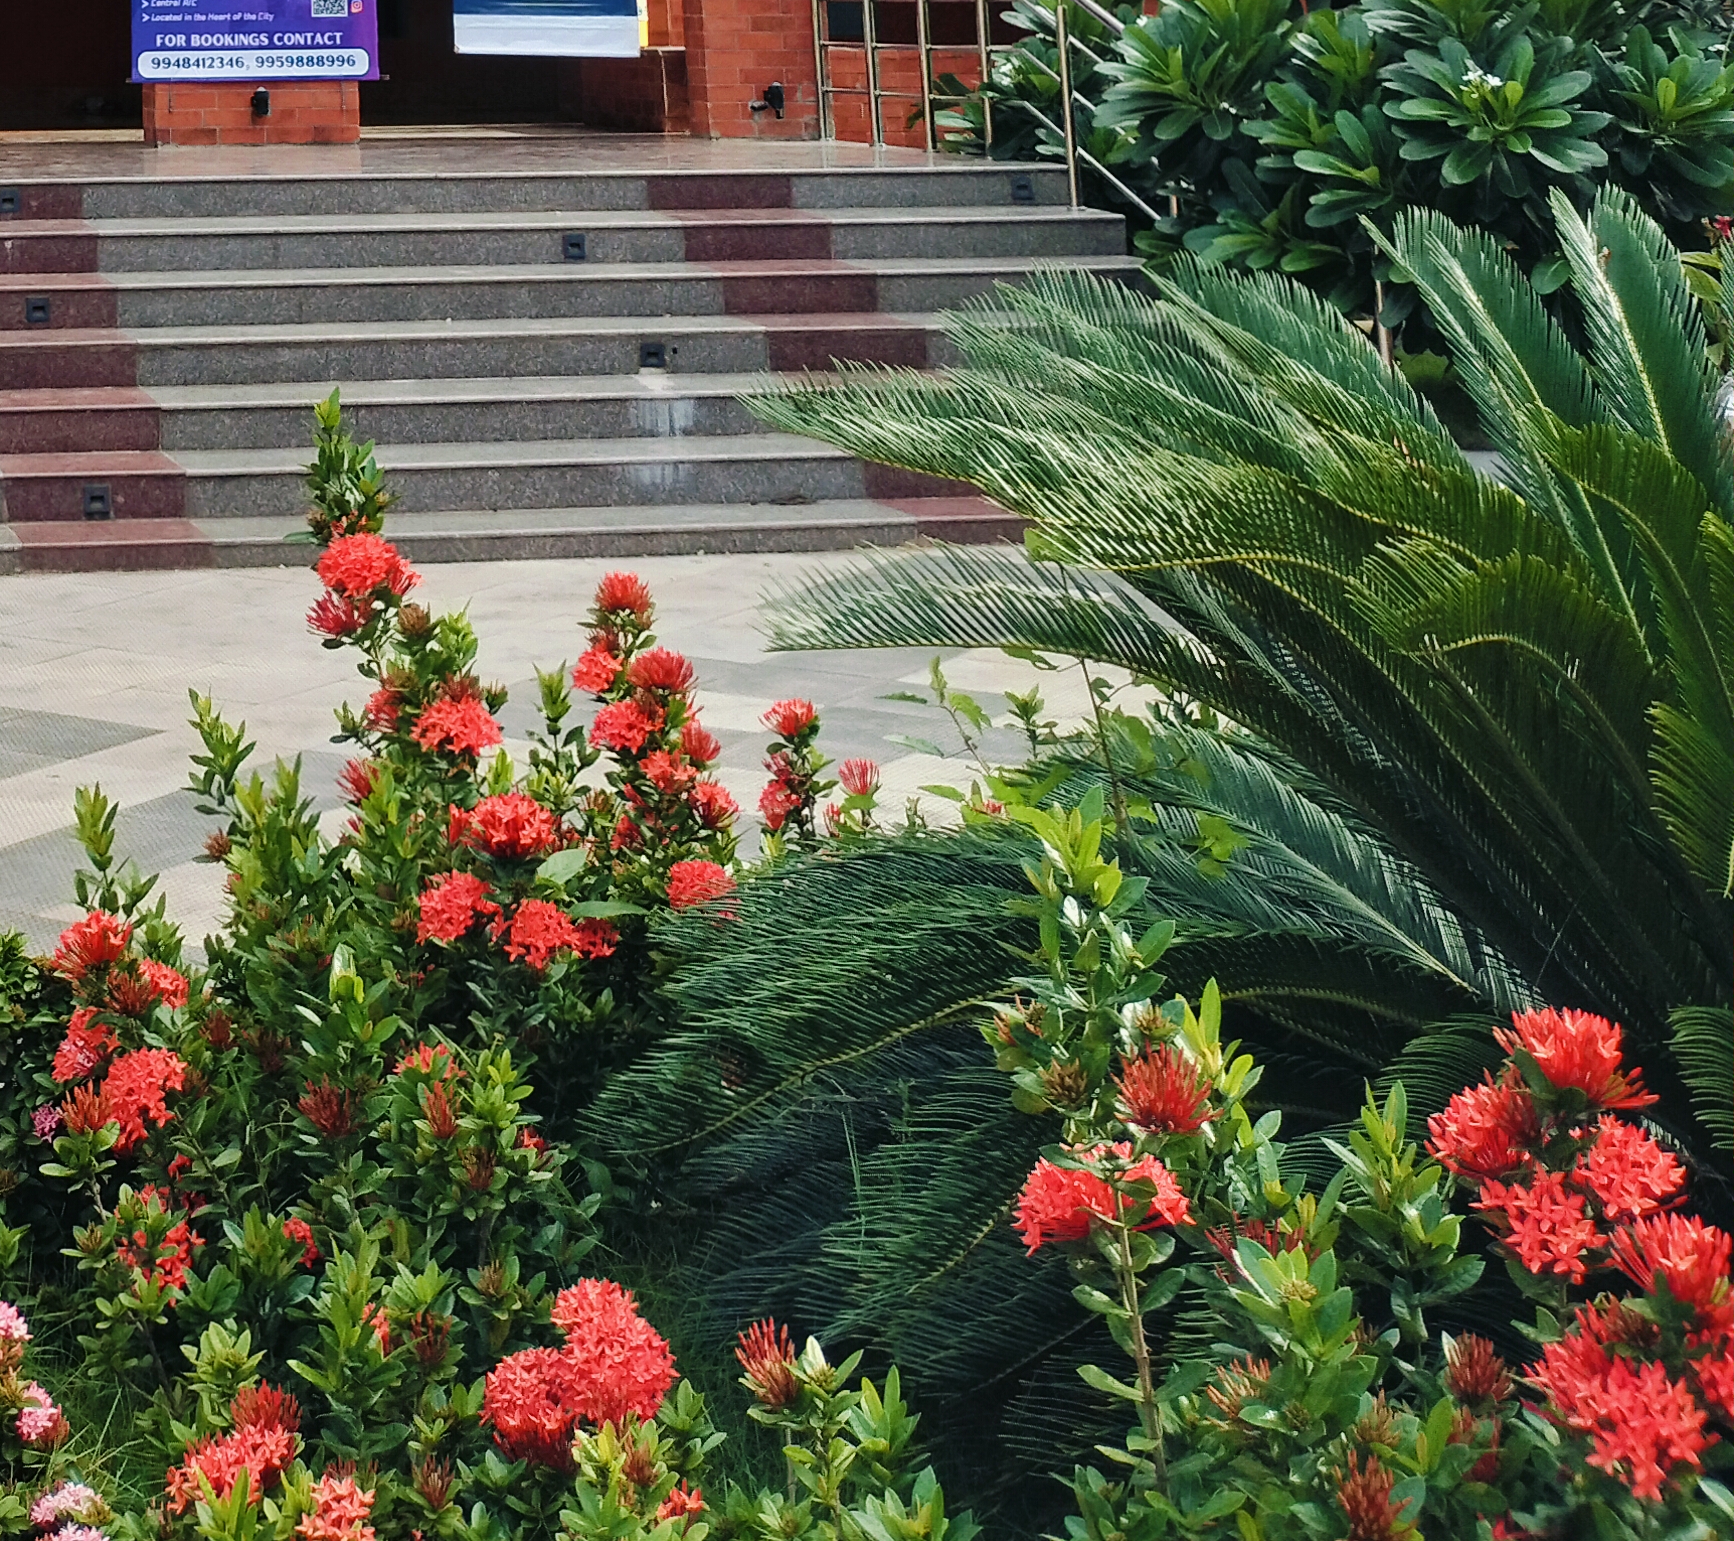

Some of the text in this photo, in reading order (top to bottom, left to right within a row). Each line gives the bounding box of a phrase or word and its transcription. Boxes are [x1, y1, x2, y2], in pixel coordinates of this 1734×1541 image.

[151, 13, 183, 22] Located
[208, 13, 231, 21] Heart
[244, 13, 257, 21] the
[258, 12, 275, 22] City
[156, 32, 343, 47] FOR BOOKINGS CONTACT
[151, 55, 356, 71] 9948412346, 9959888996
